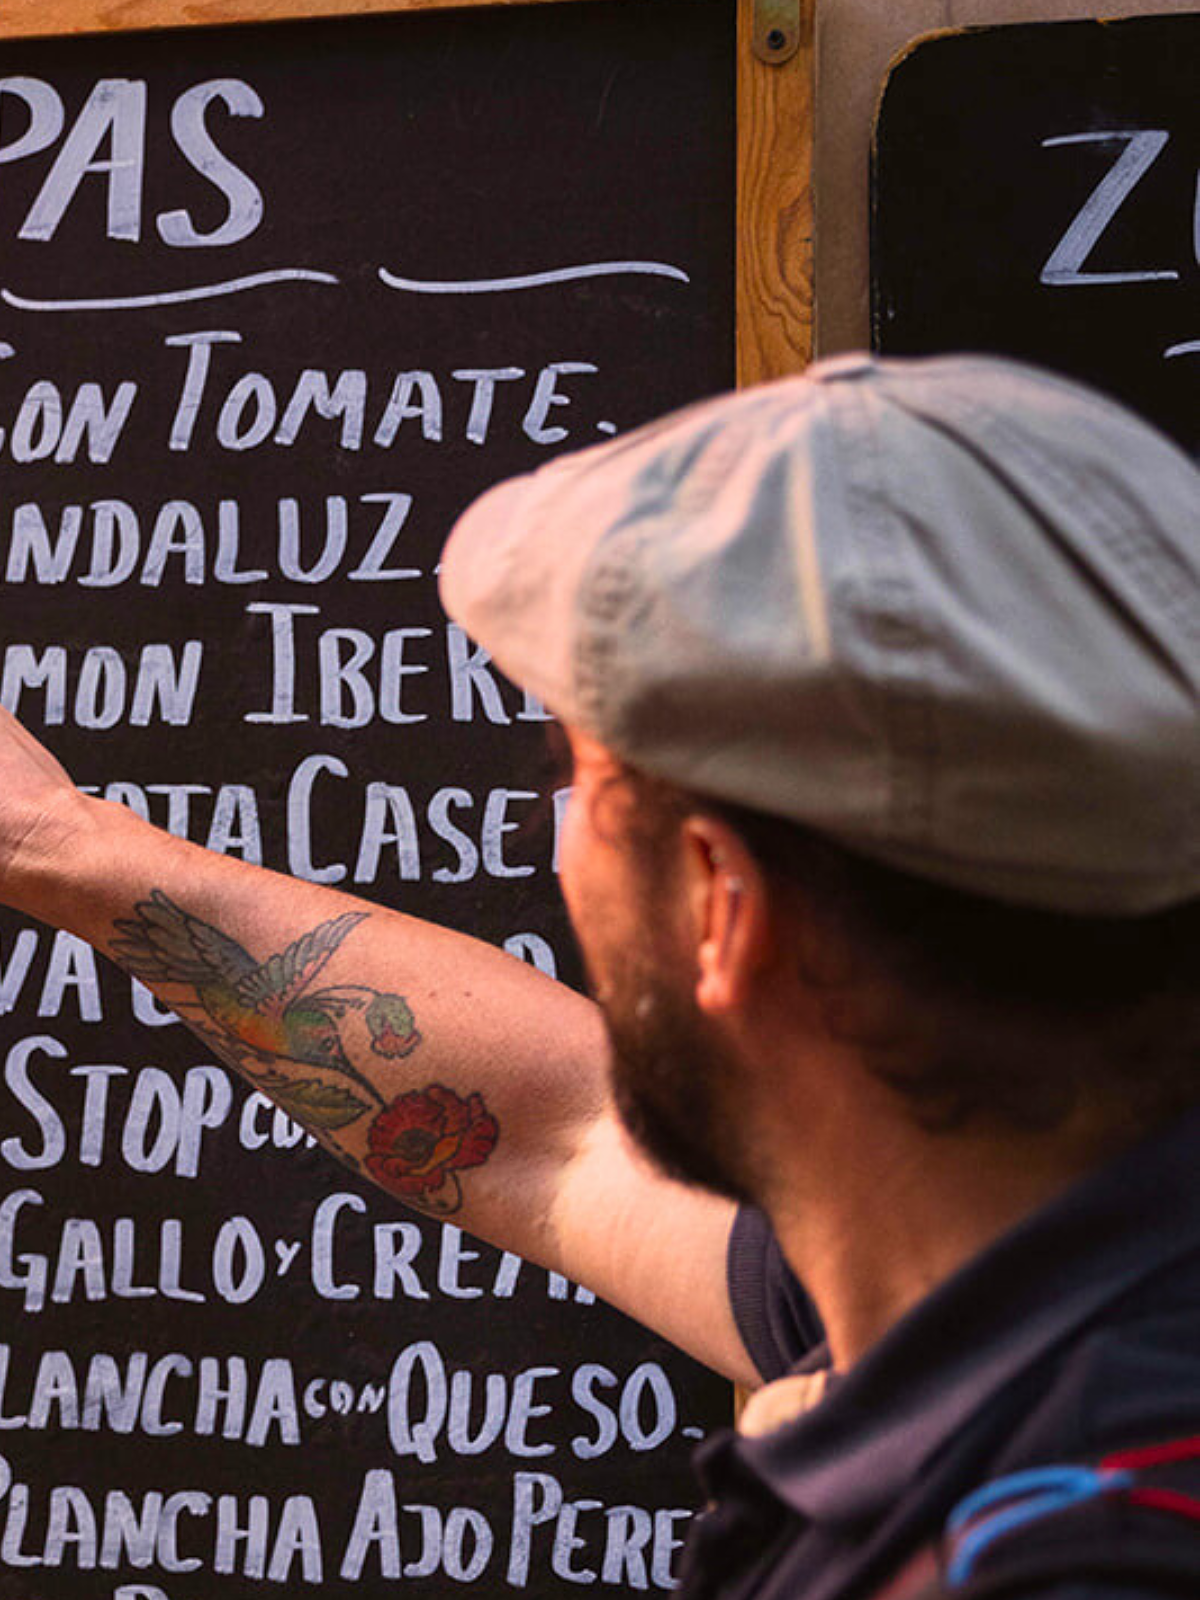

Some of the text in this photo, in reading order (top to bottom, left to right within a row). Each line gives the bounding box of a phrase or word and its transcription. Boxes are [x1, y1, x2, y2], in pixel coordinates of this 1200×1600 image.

[1042, 131, 1200, 286] Z
[288, 755, 570, 885] CASE
[1, 1036, 234, 1179] STOP
[240, 1092, 319, 1151] CO
[312, 1193, 597, 1306] CRE
[305, 1380, 387, 1419] CON
[341, 1469, 494, 1583] AJO
[508, 1472, 693, 1591] PERE
